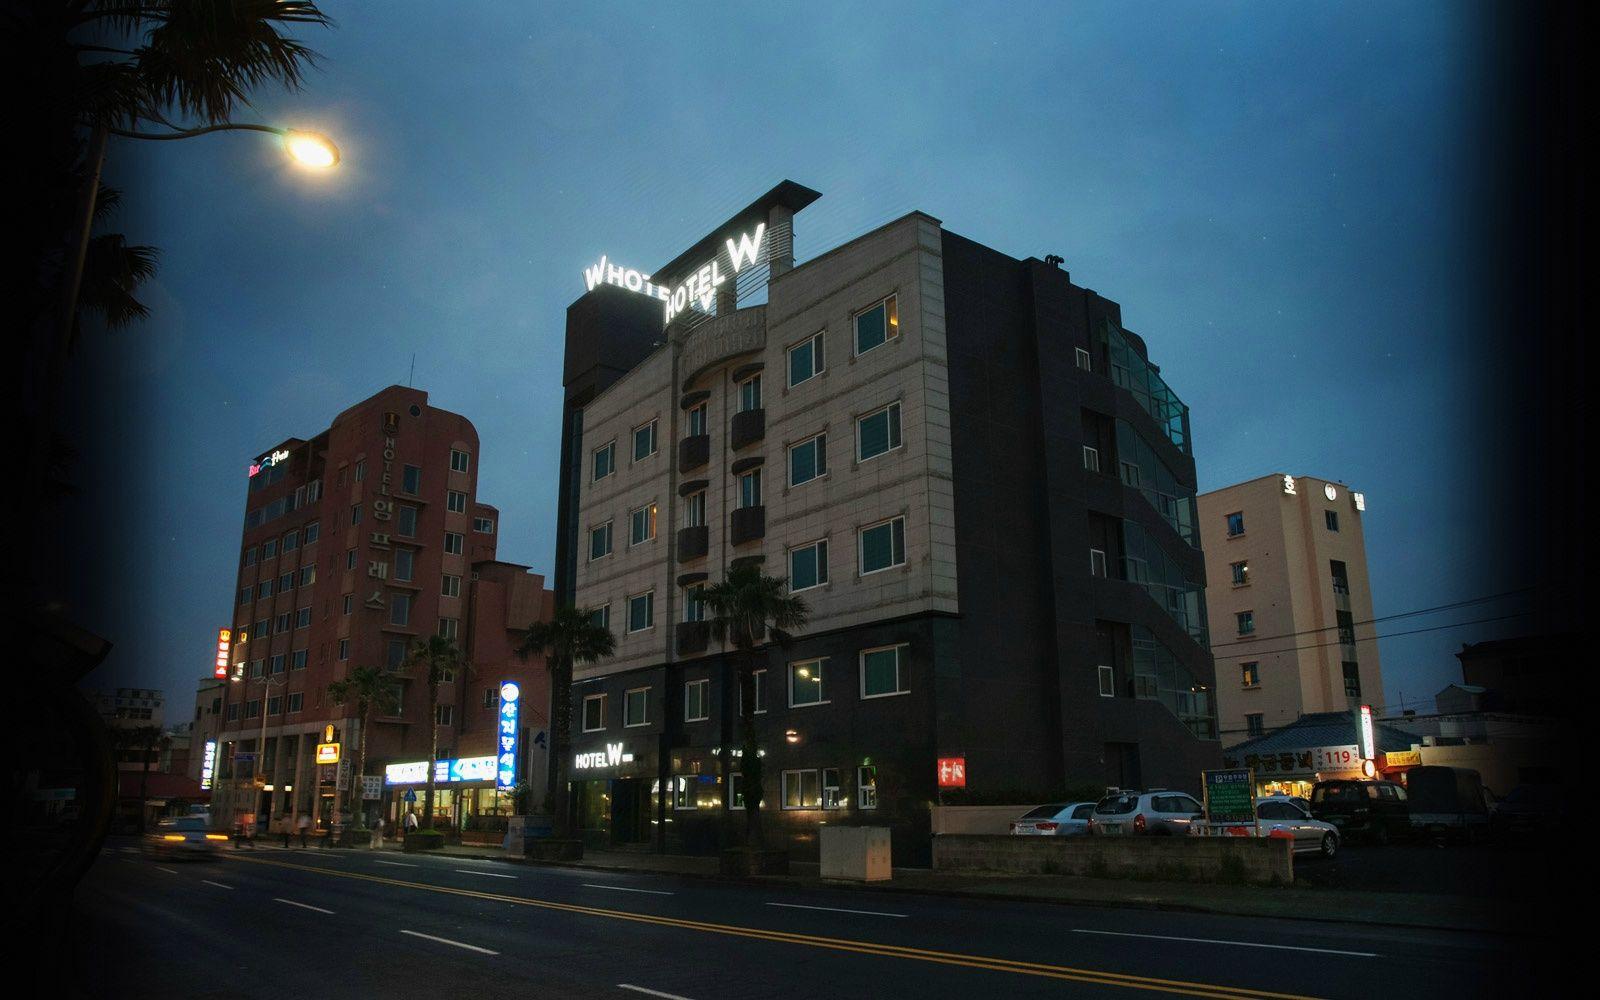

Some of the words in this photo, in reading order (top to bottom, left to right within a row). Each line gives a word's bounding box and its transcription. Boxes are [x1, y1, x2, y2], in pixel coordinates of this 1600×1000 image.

[665, 260, 726, 325] HOTEL
[726, 222, 765, 273] W
[379, 437, 394, 496] HOTEL
[575, 751, 608, 769] HOTEL
[607, 742, 623, 767] W
[1325, 750, 1350, 763] 119
